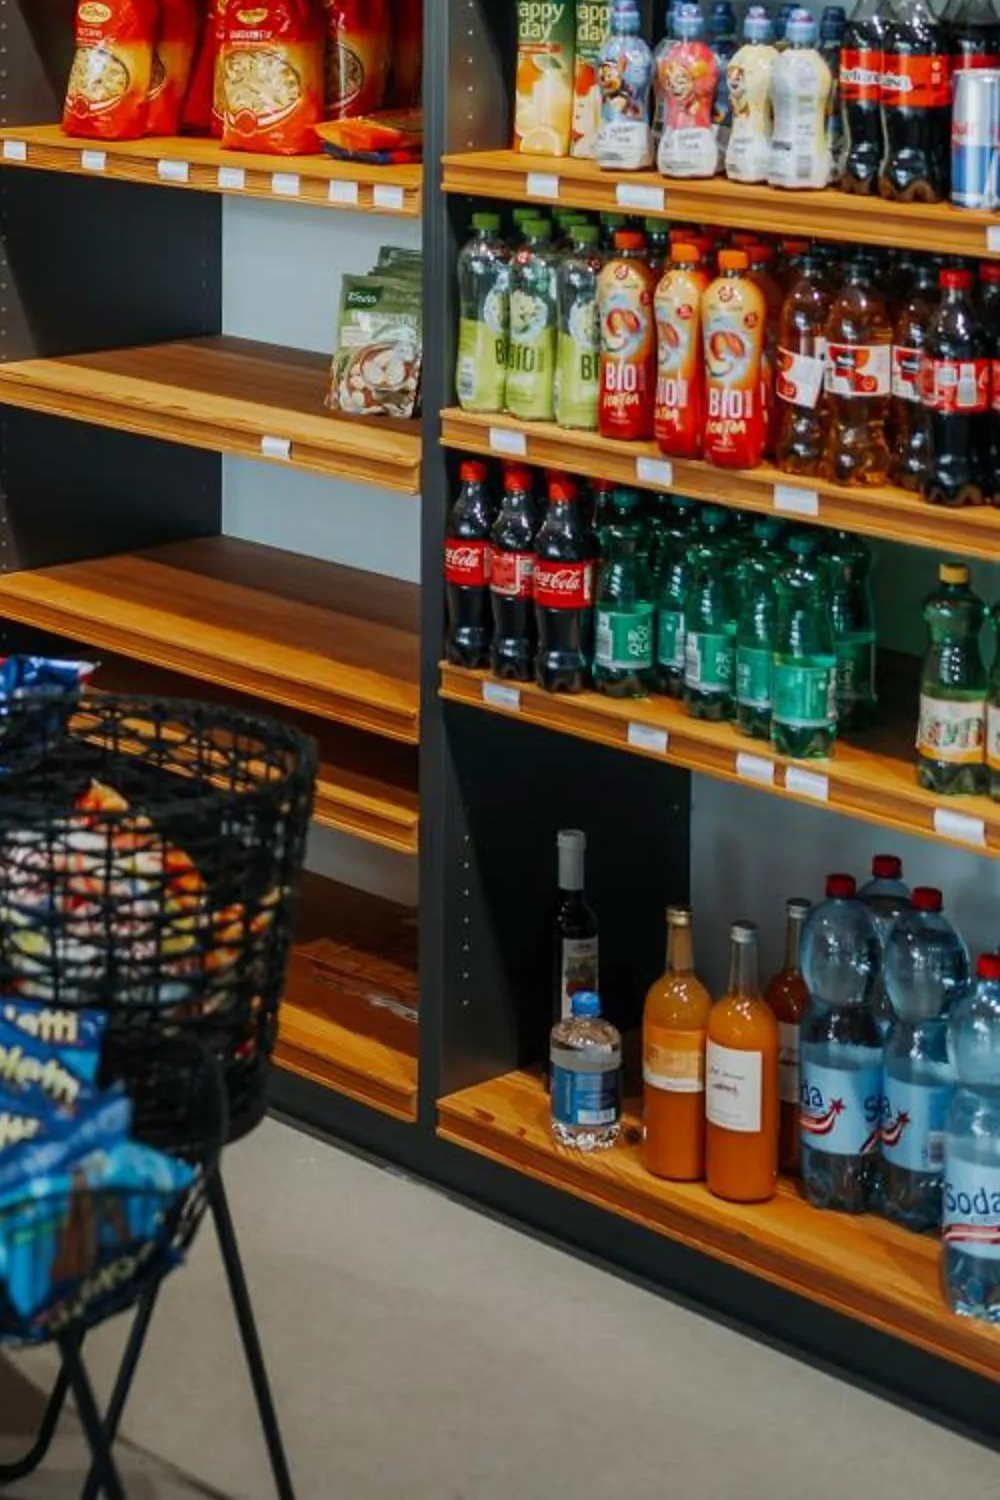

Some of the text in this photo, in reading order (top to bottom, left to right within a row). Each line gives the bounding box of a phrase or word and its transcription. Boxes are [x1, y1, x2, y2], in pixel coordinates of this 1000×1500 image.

[518, 2, 565, 24] appy
[519, 19, 553, 43] day
[605, 360, 638, 391] BIO
[708, 387, 743, 419] BIO
